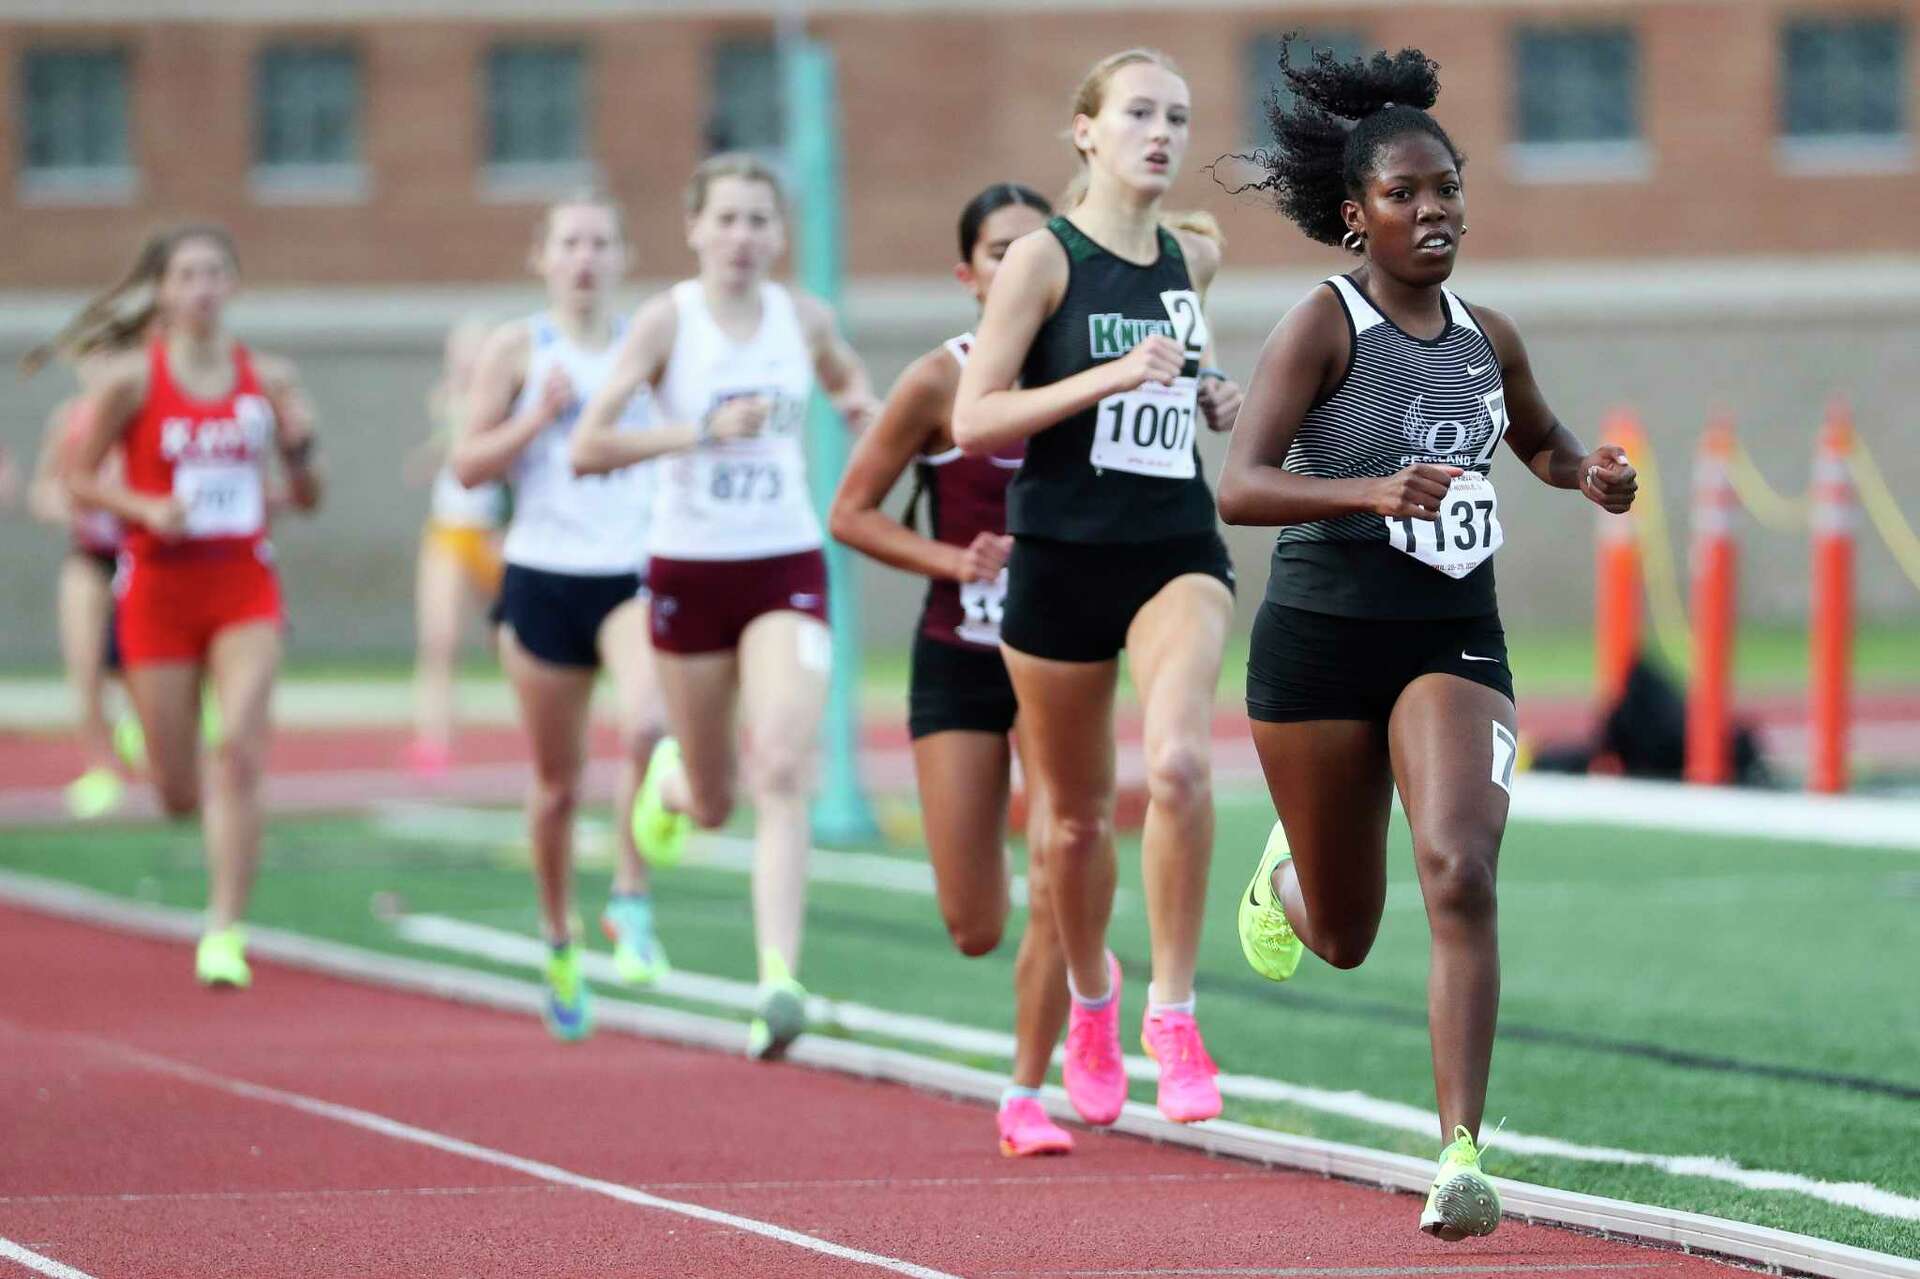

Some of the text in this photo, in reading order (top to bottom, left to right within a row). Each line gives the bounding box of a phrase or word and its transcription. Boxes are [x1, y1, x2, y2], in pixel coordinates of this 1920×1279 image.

[1173, 298, 1202, 352] 2
[1106, 400, 1191, 450] 1007
[1425, 420, 1466, 454] O
[1393, 500, 1494, 553] 1137
[1496, 727, 1516, 788] 7
